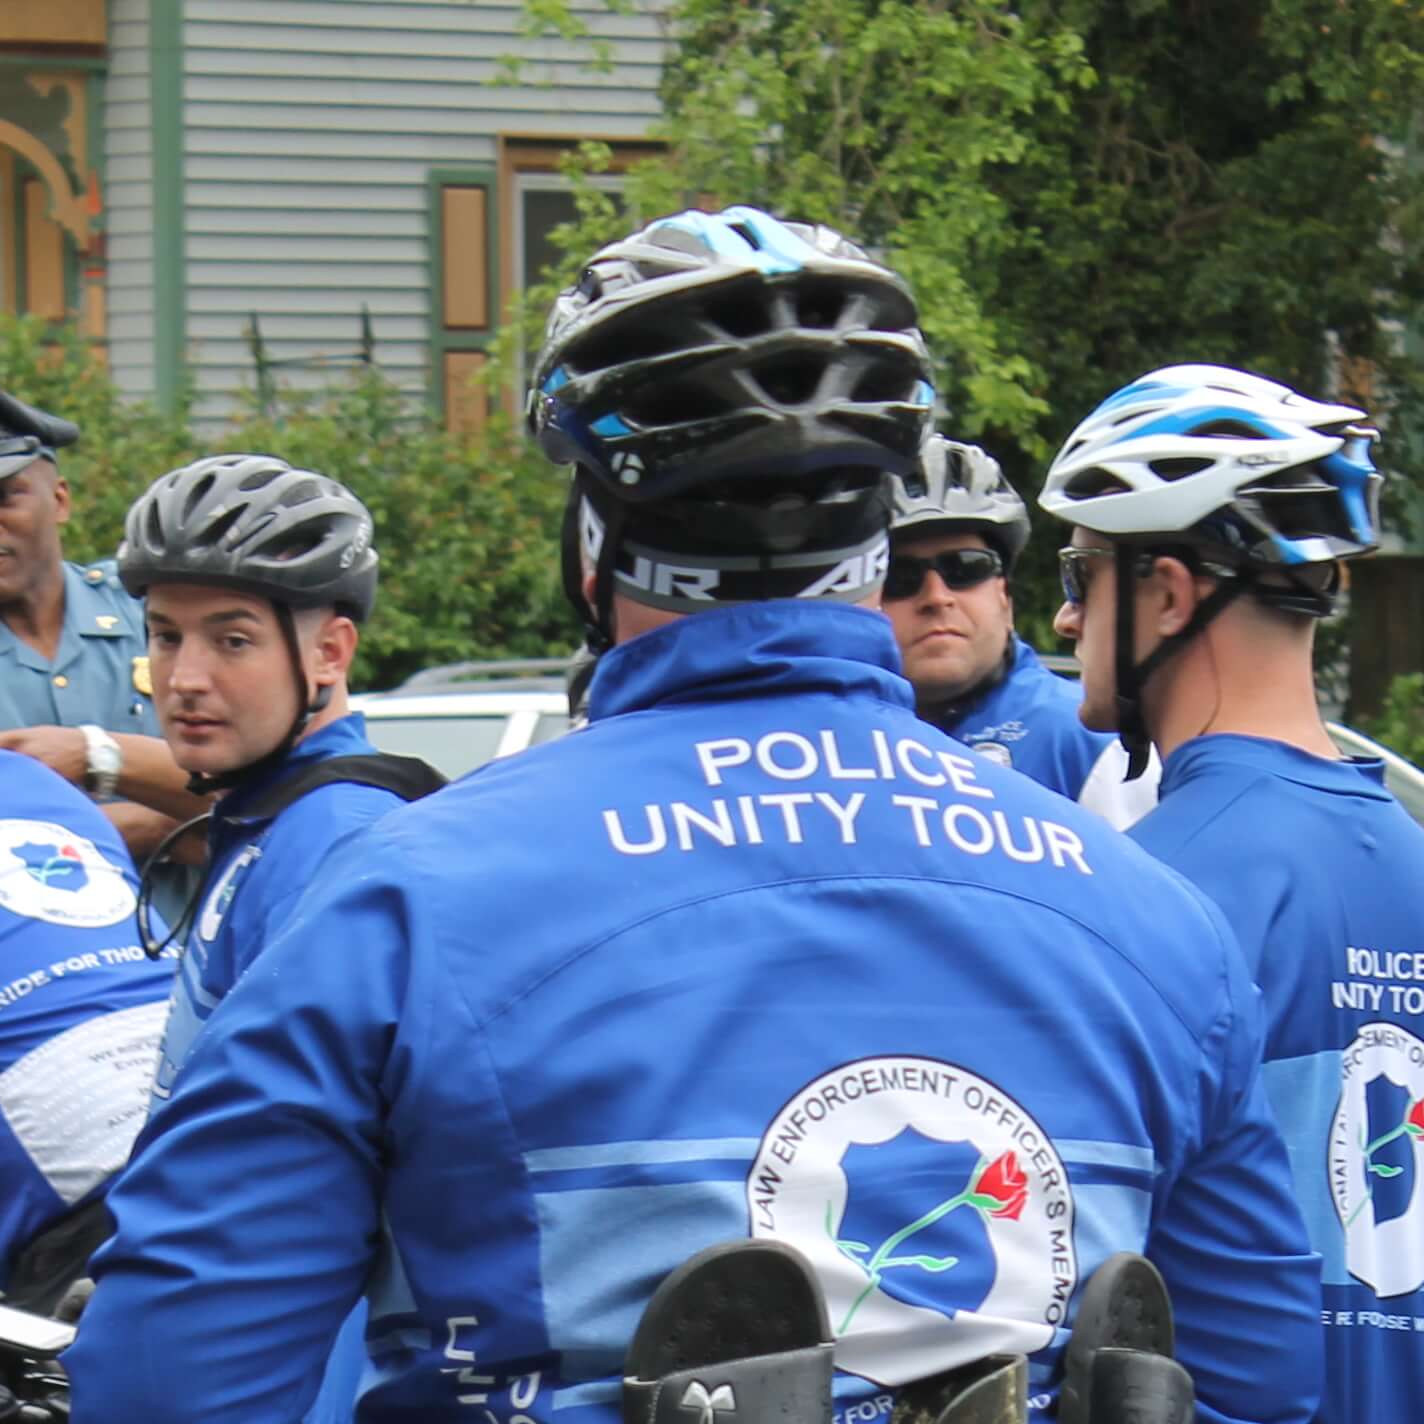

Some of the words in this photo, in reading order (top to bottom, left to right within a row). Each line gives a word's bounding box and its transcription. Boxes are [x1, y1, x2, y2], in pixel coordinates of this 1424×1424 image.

[695, 729, 995, 800] POLICE
[602, 793, 862, 857] UNITY
[891, 793, 1094, 877] TOUR
[49, 951, 103, 977] FOR
[754, 1163, 784, 1231] LAW
[771, 1066, 959, 1165] ENFORCEMENT
[963, 1085, 1067, 1220] OFFICER'S
[1044, 1229, 1072, 1326] MEMO
